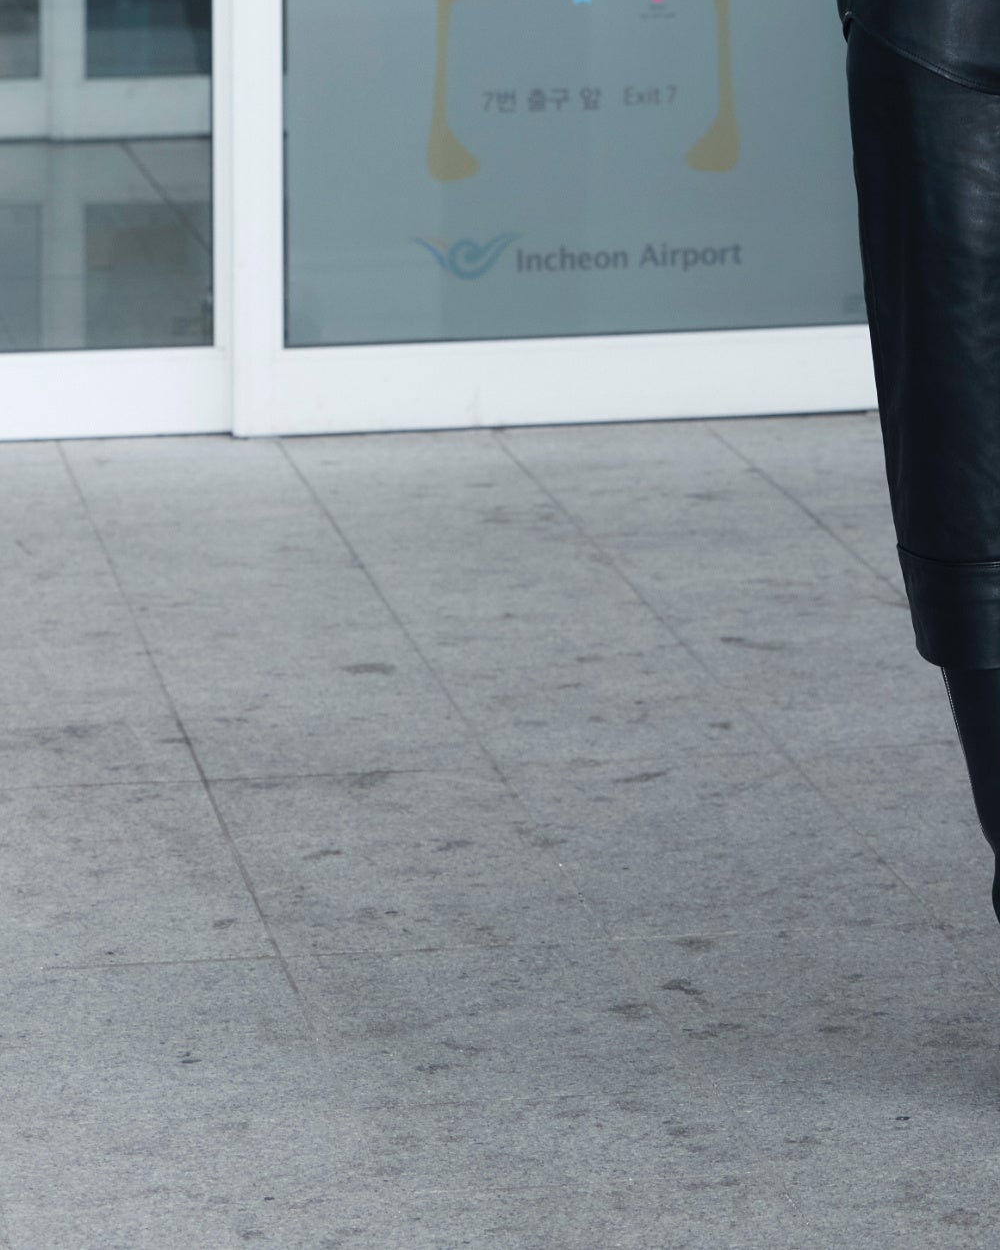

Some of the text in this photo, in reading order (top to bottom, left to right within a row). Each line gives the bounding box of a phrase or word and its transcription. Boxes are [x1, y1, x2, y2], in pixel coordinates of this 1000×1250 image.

[482, 90, 517, 113] 7번
[527, 88, 571, 112] 출구
[624, 87, 661, 107] Exit
[666, 85, 679, 106] 7
[515, 242, 743, 275] Incheon Airport
